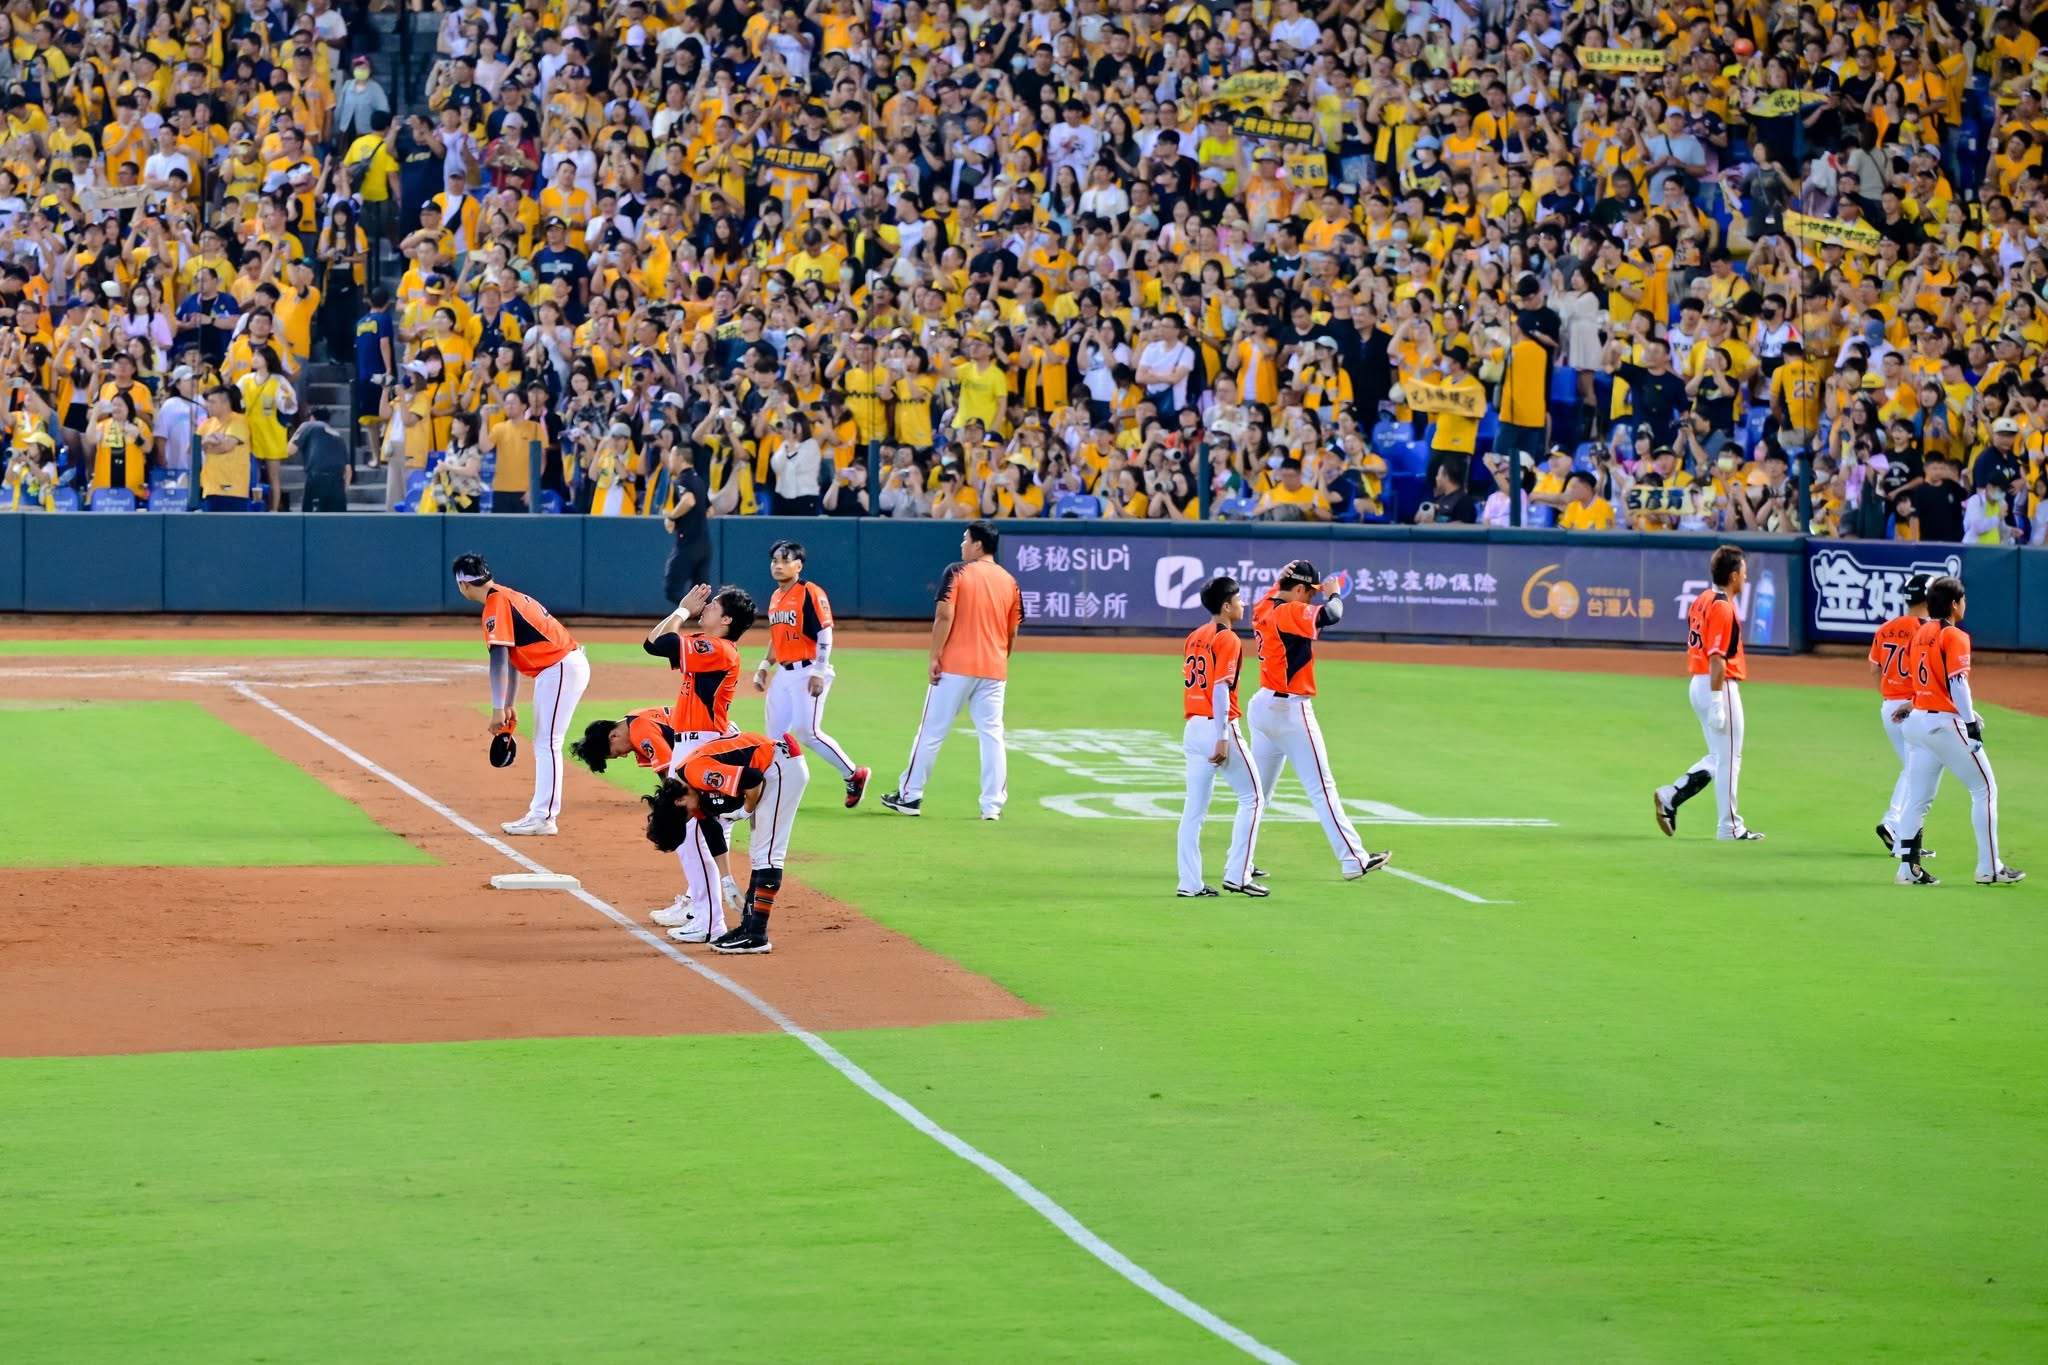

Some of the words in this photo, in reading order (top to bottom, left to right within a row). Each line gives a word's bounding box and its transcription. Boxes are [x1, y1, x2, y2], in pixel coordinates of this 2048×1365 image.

[1213, 560, 1281, 583] ezTrav
[1020, 591, 1128, 620] 星和診所
[1674, 580, 1751, 622] FN
[786, 631, 799, 642] 14
[1917, 651, 1929, 686] 6
